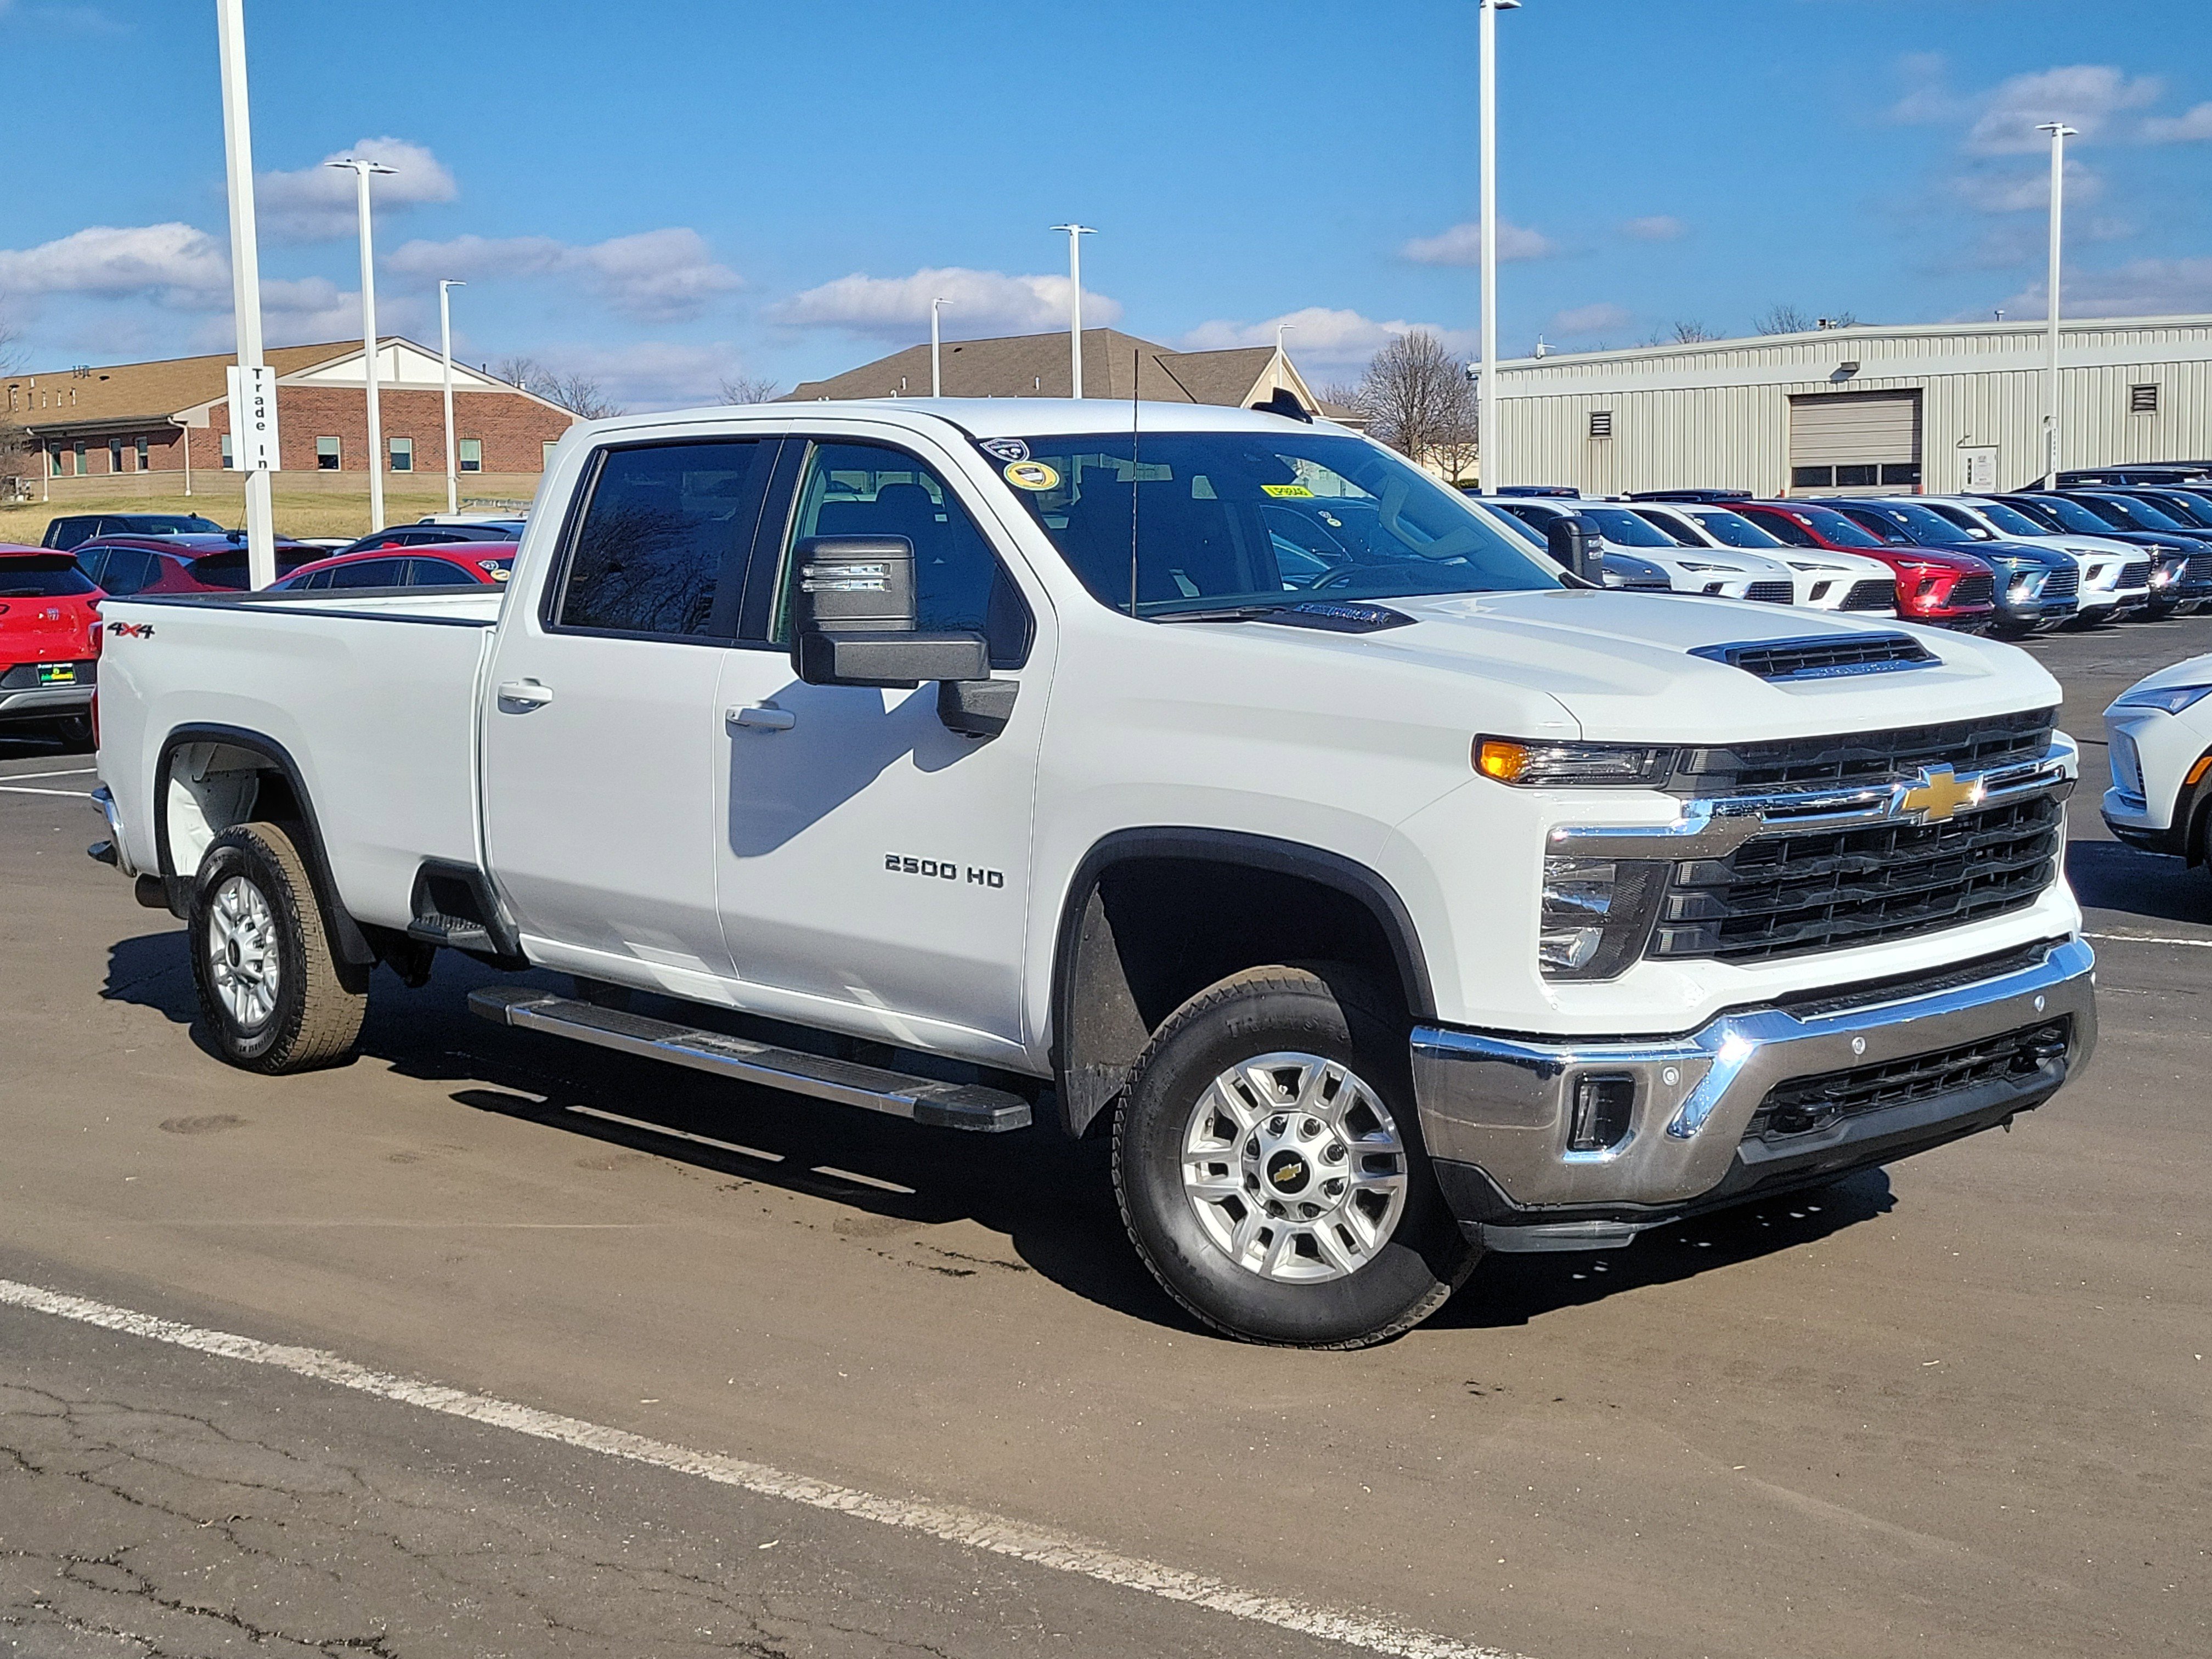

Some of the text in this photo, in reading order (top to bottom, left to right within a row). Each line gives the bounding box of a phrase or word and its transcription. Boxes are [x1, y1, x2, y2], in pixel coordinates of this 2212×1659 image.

[252, 368, 268, 470] Trade In
[885, 854, 1003, 888] 2500 HD
